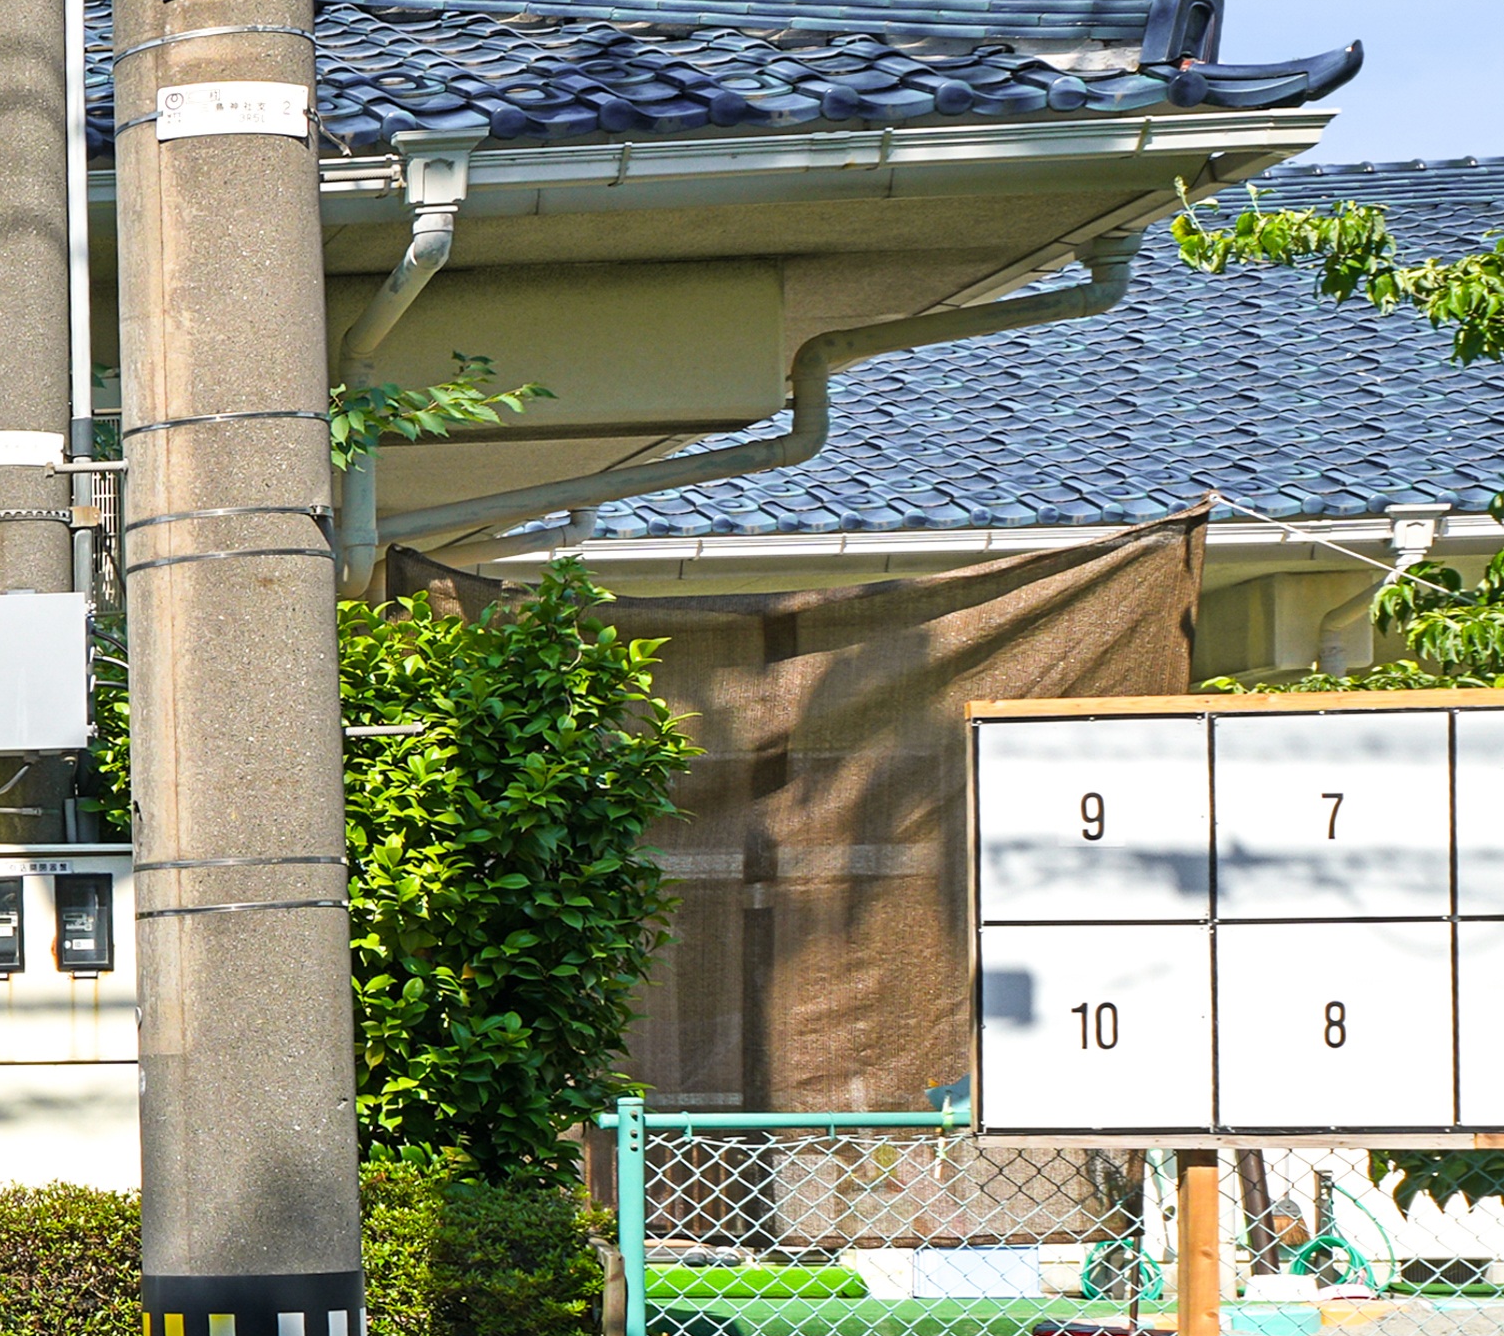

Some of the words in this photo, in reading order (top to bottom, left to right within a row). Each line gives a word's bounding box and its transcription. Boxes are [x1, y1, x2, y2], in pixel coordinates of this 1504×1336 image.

[282, 100, 291, 115] 2
[1080, 792, 1105, 841] 9
[1321, 792, 1344, 840] 7
[1071, 1002, 1119, 1050] 10
[1324, 1001, 1346, 1049] 8
